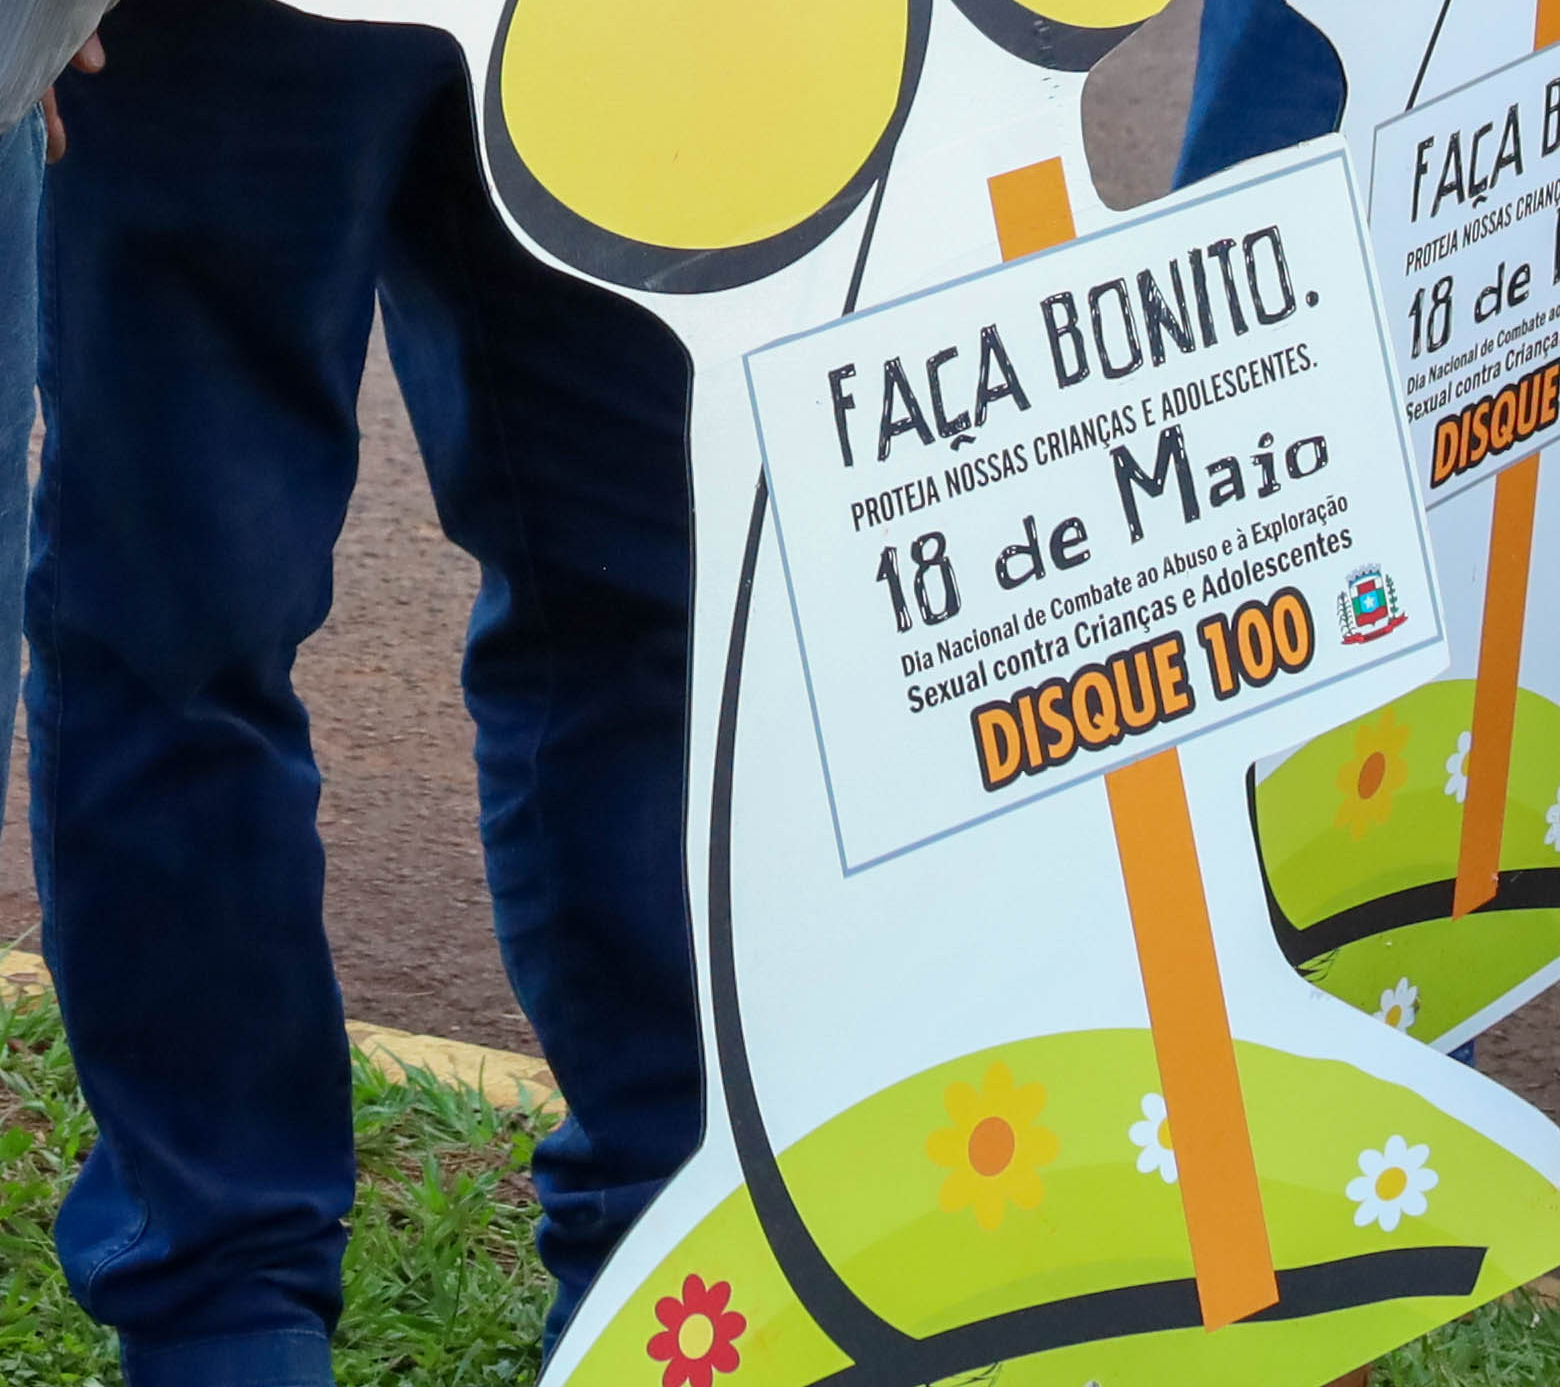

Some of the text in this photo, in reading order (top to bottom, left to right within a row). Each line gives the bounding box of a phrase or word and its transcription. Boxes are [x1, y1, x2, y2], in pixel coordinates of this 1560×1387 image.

[1405, 229, 1458, 276] PROTEJA
[1462, 203, 1512, 248] NOSSAS
[1411, 102, 1523, 223] FAÇA
[828, 225, 1320, 467] FAÇA BONITO.
[1406, 380, 1451, 424] Sexual
[1455, 361, 1501, 398] contra
[1407, 275, 1454, 359] 18
[1474, 261, 1531, 324] de
[1407, 374, 1426, 396] Dia
[1429, 343, 1478, 384] Nacional
[1481, 337, 1494, 358] de
[1497, 312, 1546, 348] Combate
[851, 343, 1318, 532] PROTEJA NOSSAS CRIANÇAS E ADOLESCENTES.
[876, 424, 1329, 633] 18 de Maio
[901, 495, 1348, 678] Dia Nacional de Combate ao Abuso e à Exploração
[907, 528, 1353, 713] Sexual contra Crianças e Adolescentes
[971, 586, 1316, 792] DISQUE 100
